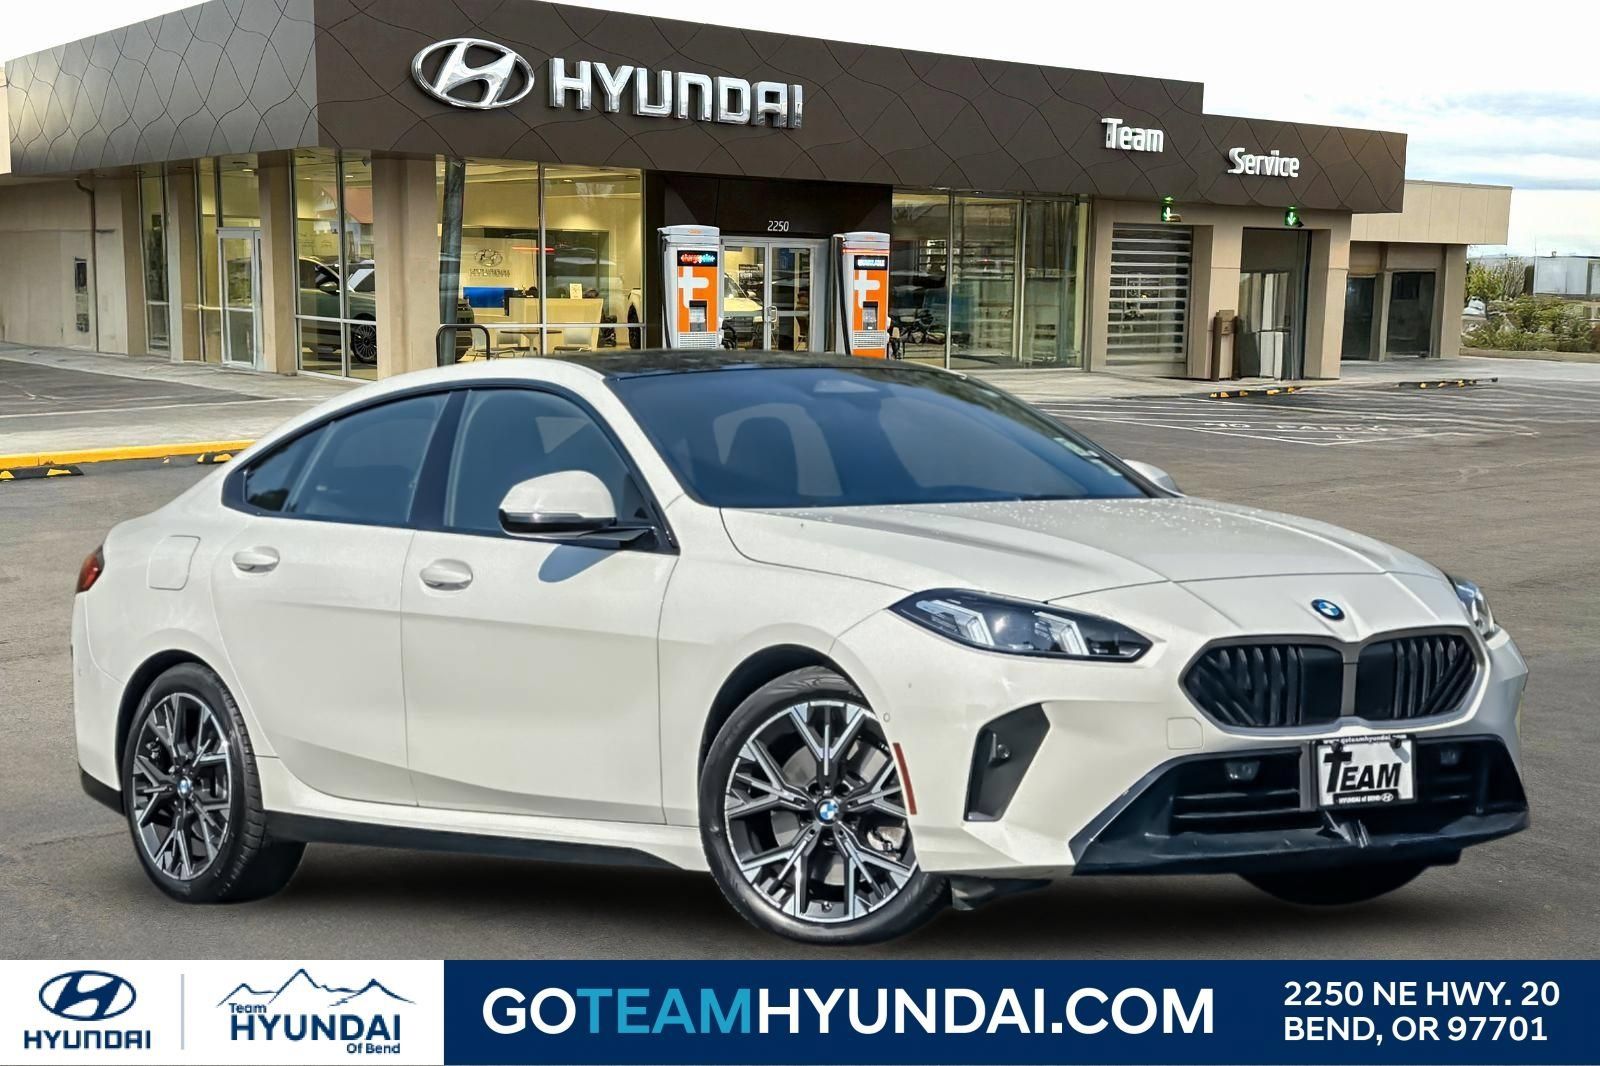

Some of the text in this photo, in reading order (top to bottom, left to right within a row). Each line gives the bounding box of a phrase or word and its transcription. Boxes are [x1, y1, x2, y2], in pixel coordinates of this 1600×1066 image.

[549, 57, 803, 128] HYUNDAI
[1101, 117, 1164, 153] Team
[1227, 147, 1300, 178] Service
[767, 220, 790, 232] 2250
[1323, 751, 1402, 794] TEAM
